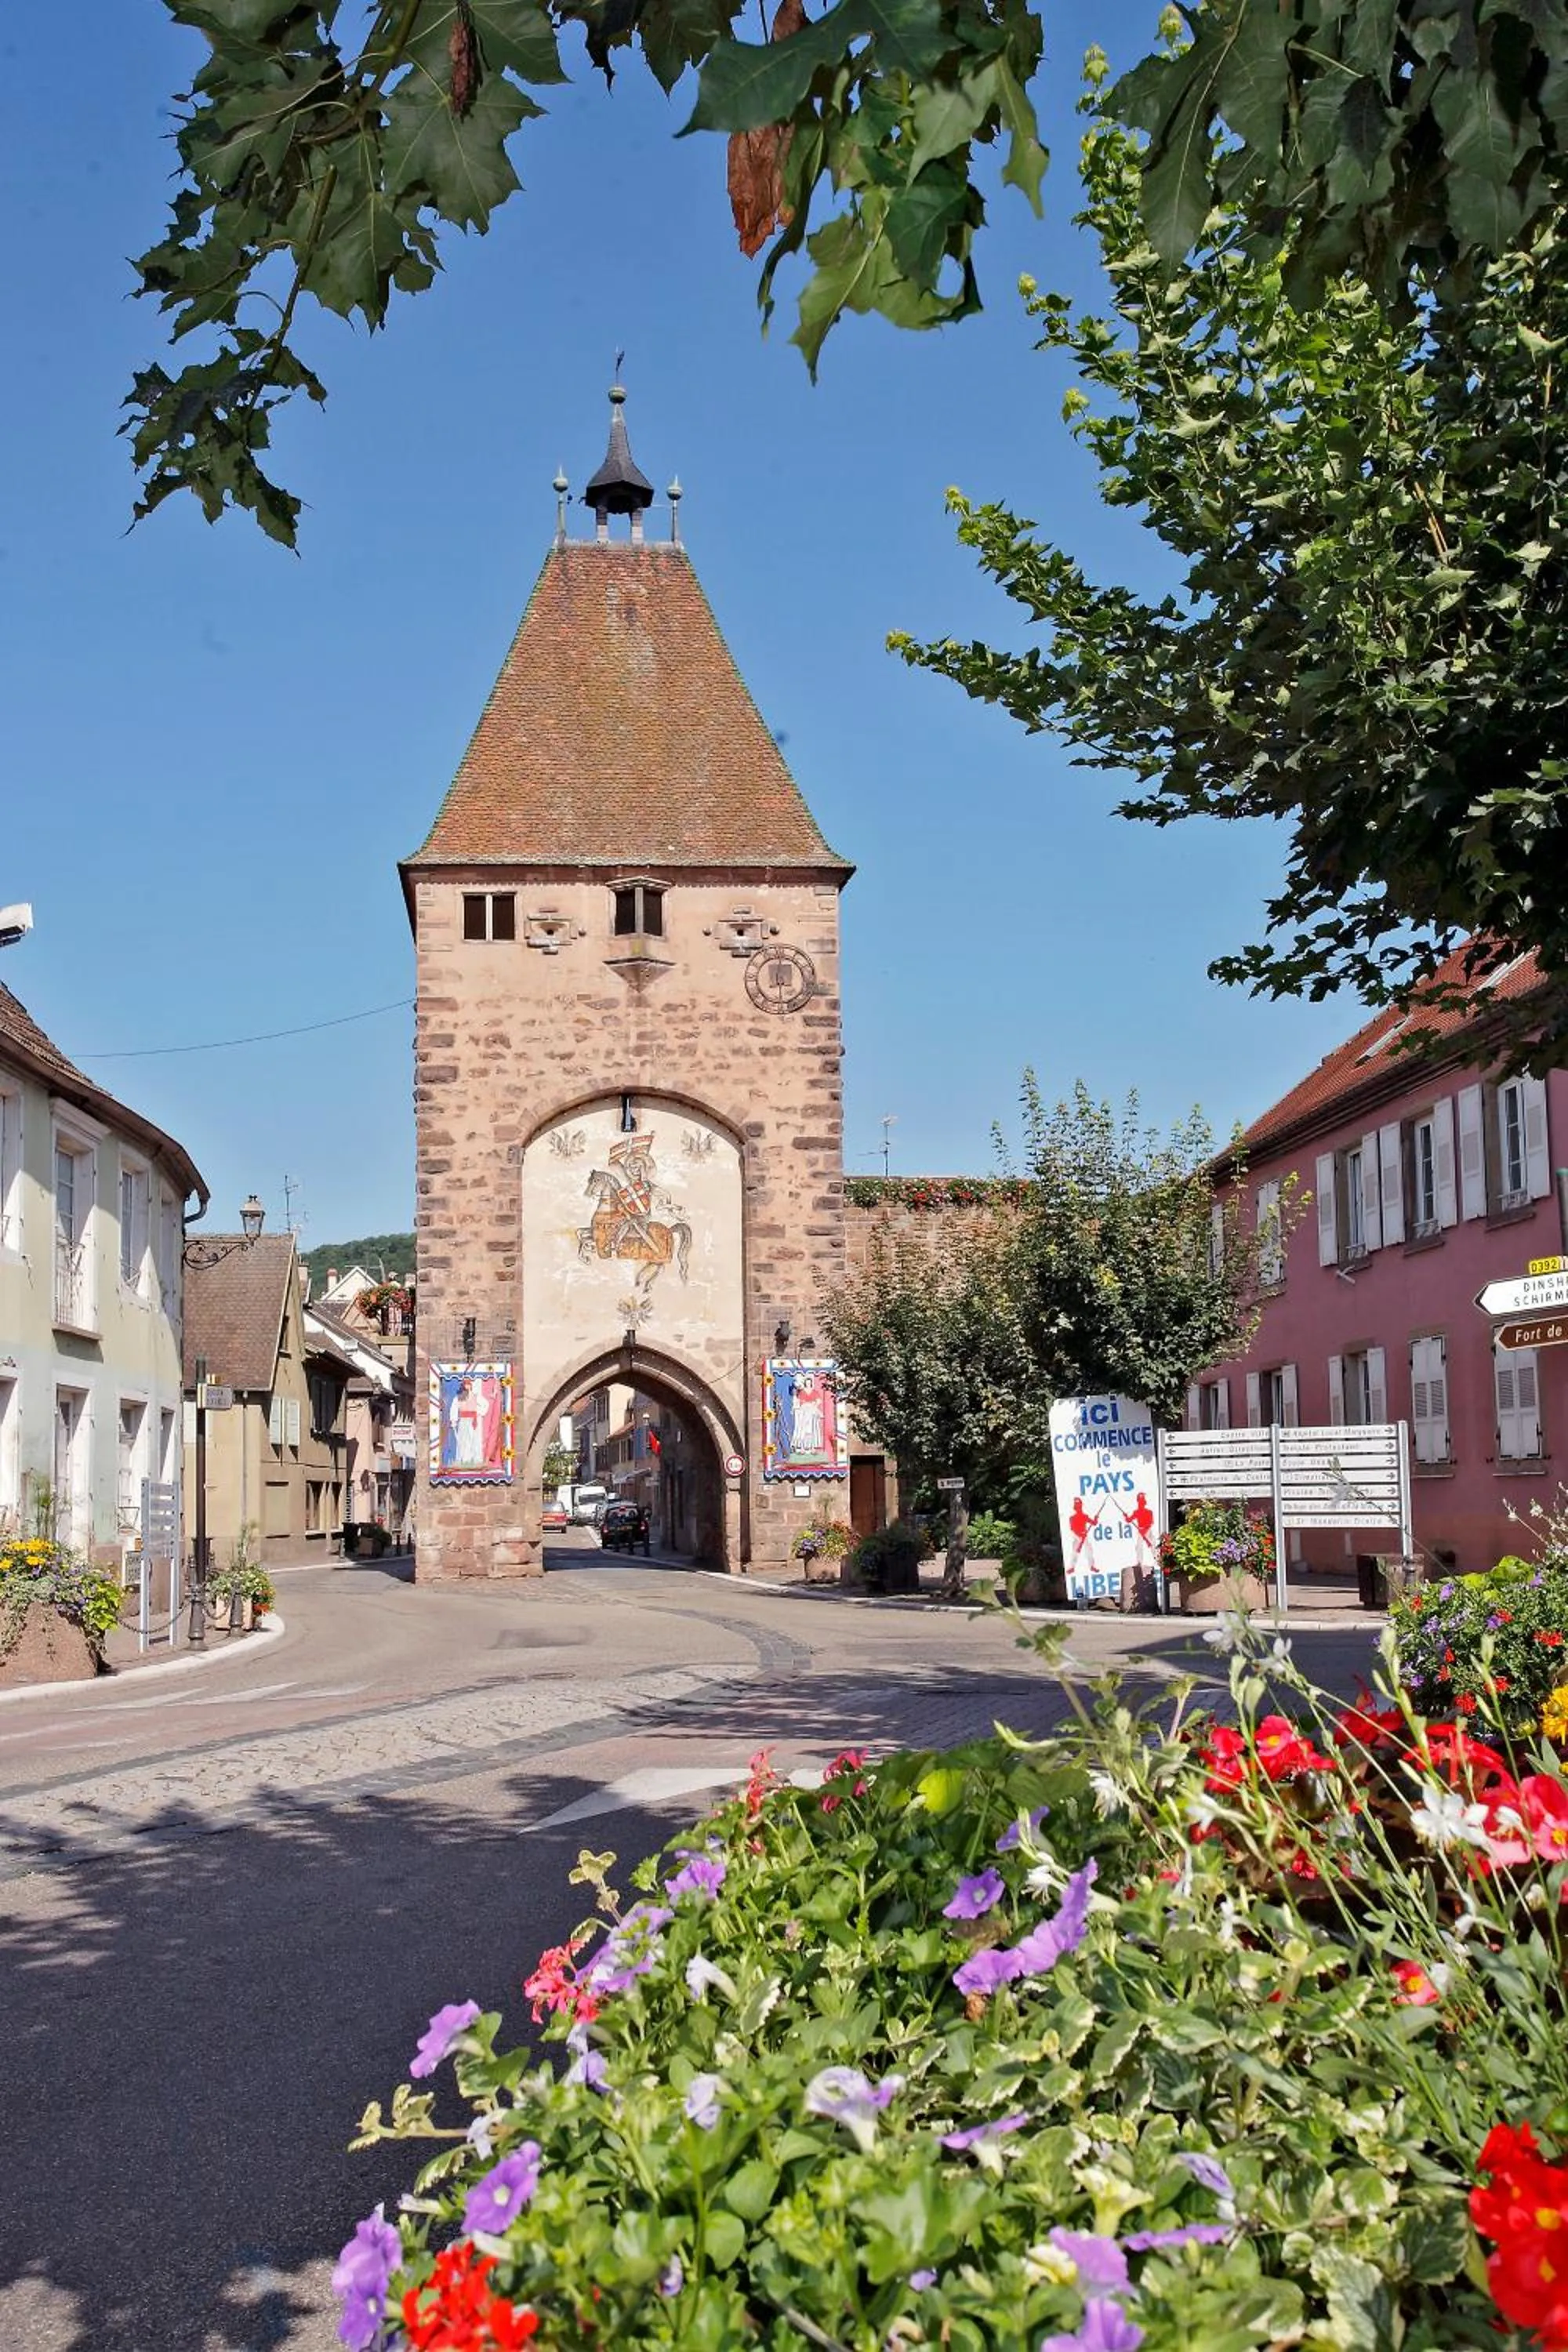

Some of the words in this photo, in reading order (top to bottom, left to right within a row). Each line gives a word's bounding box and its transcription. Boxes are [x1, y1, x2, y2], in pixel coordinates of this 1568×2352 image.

[1530, 1258, 1558, 1272] D392
[1515, 1327, 1541, 1343] Fort
[1547, 1323, 1563, 1338] de
[1078, 1396, 1120, 1425] ici
[1053, 1425, 1153, 1453] COMMENCE
[1096, 1450, 1112, 1468] le
[1078, 1469, 1135, 1496] PAYS
[1093, 1523, 1113, 1541] de
[1118, 1520, 1133, 1539] la
